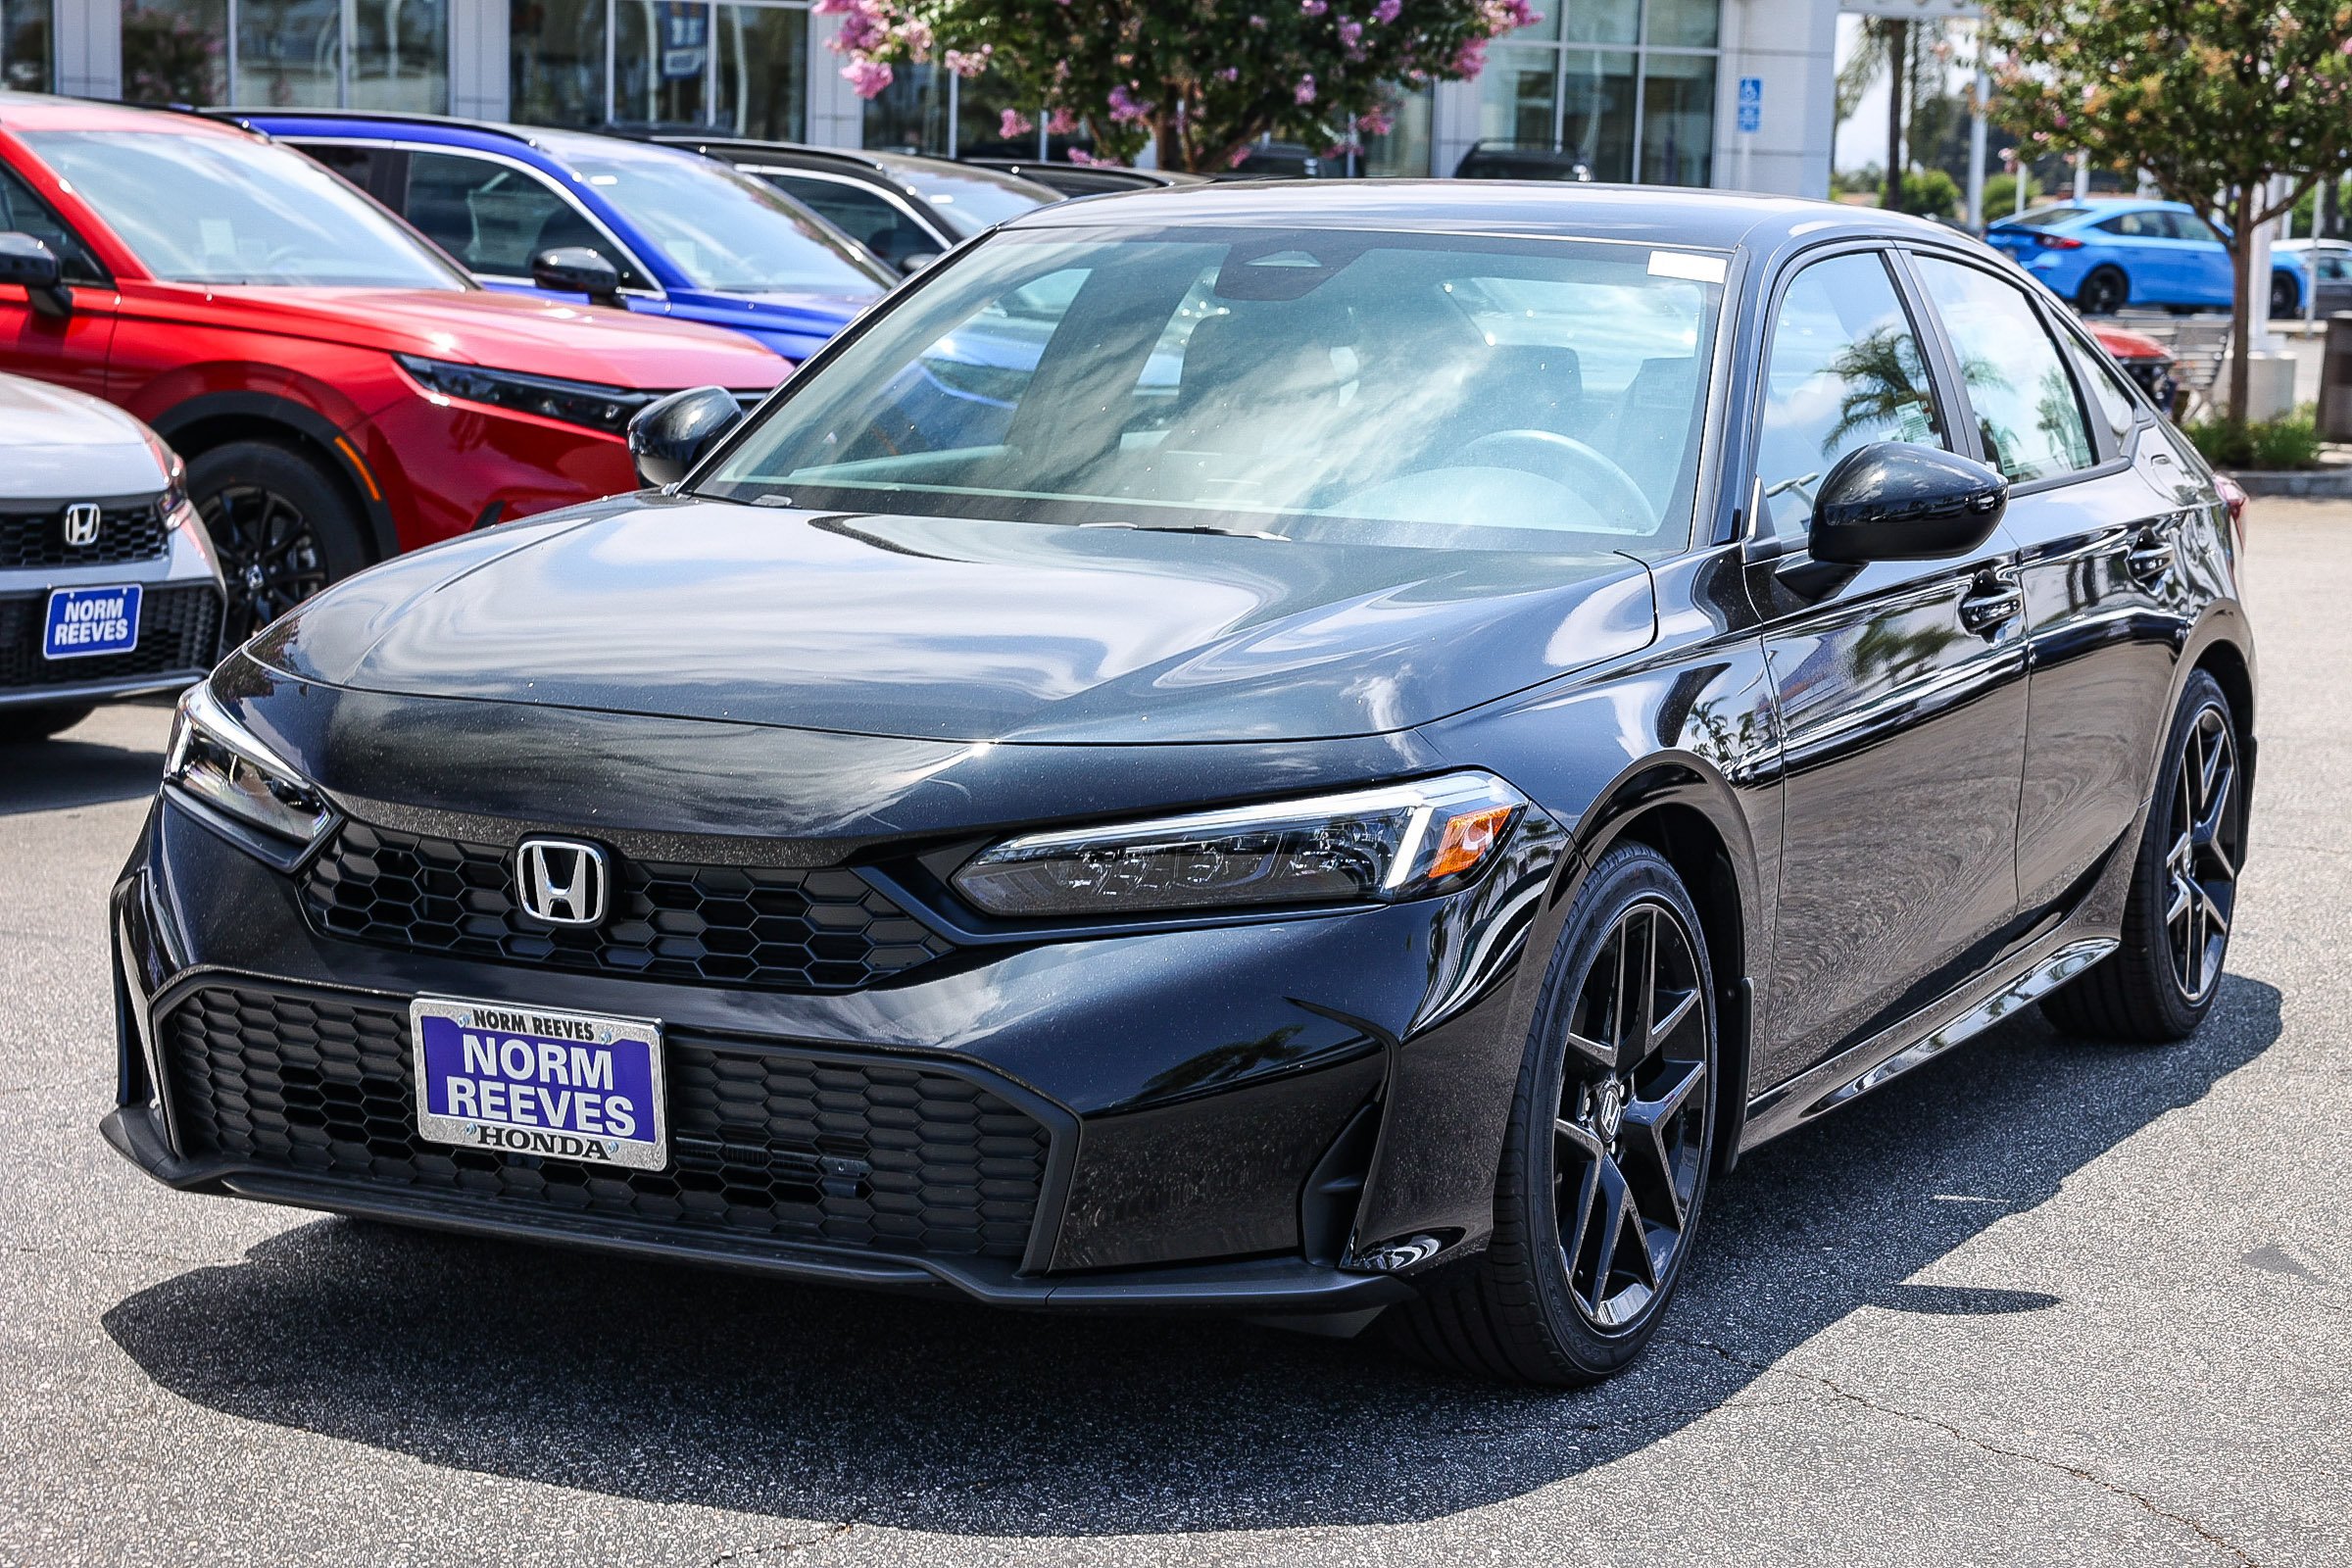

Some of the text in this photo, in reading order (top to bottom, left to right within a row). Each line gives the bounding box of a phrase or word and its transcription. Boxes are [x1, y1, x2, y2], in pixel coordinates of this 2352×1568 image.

[65, 597, 124, 622] NORM
[54, 618, 128, 646] REEVES
[472, 1008, 595, 1042] NORM REEVES
[463, 1033, 613, 1091] NORM
[446, 1075, 636, 1137] REEVES
[476, 1124, 611, 1161] HONDA
